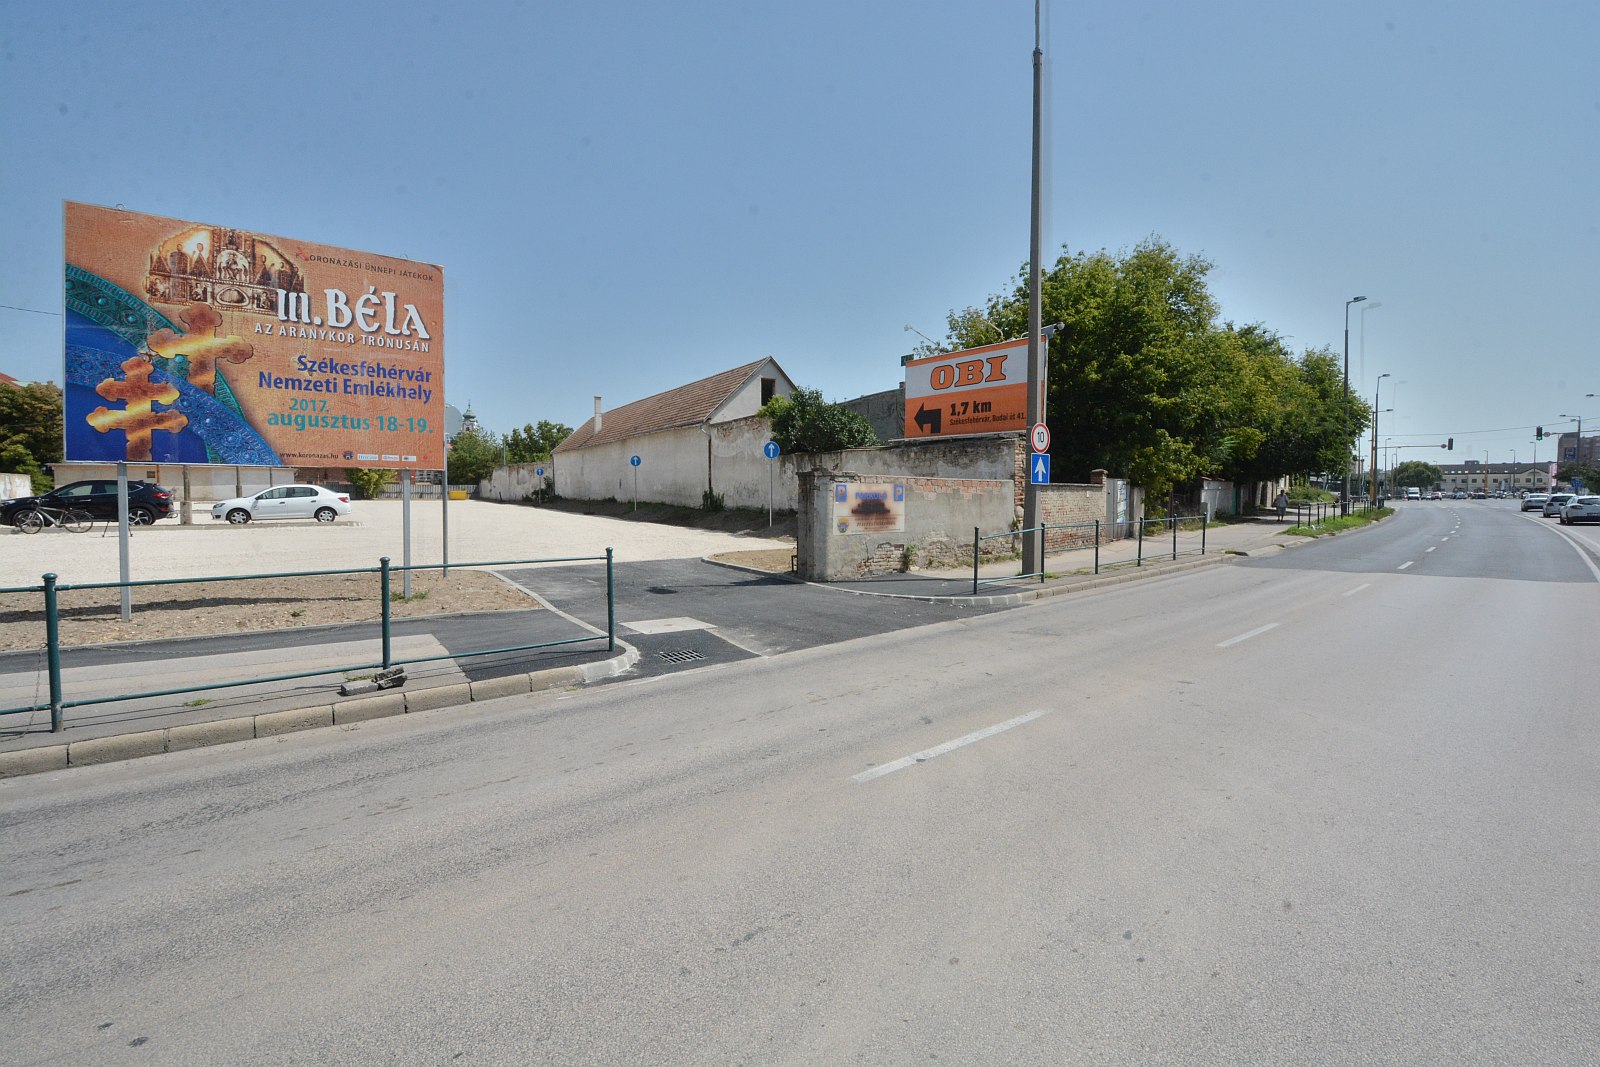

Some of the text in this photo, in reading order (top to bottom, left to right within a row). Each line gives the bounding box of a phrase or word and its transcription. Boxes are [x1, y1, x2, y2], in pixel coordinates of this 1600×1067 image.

[324, 285, 431, 340] BÉLA
[255, 322, 430, 353] AZ ARANYKOR TRÓNUSÁN
[297, 355, 432, 383] Székesfehérvár
[930, 355, 1008, 390] OBI
[258, 371, 432, 404] Nemzeti Emlékhely
[289, 398, 330, 413] 2017.
[950, 401, 992, 417] 1,7 km
[267, 412, 433, 433] augusztus 18-19.
[1037, 431, 1045, 443] 10
